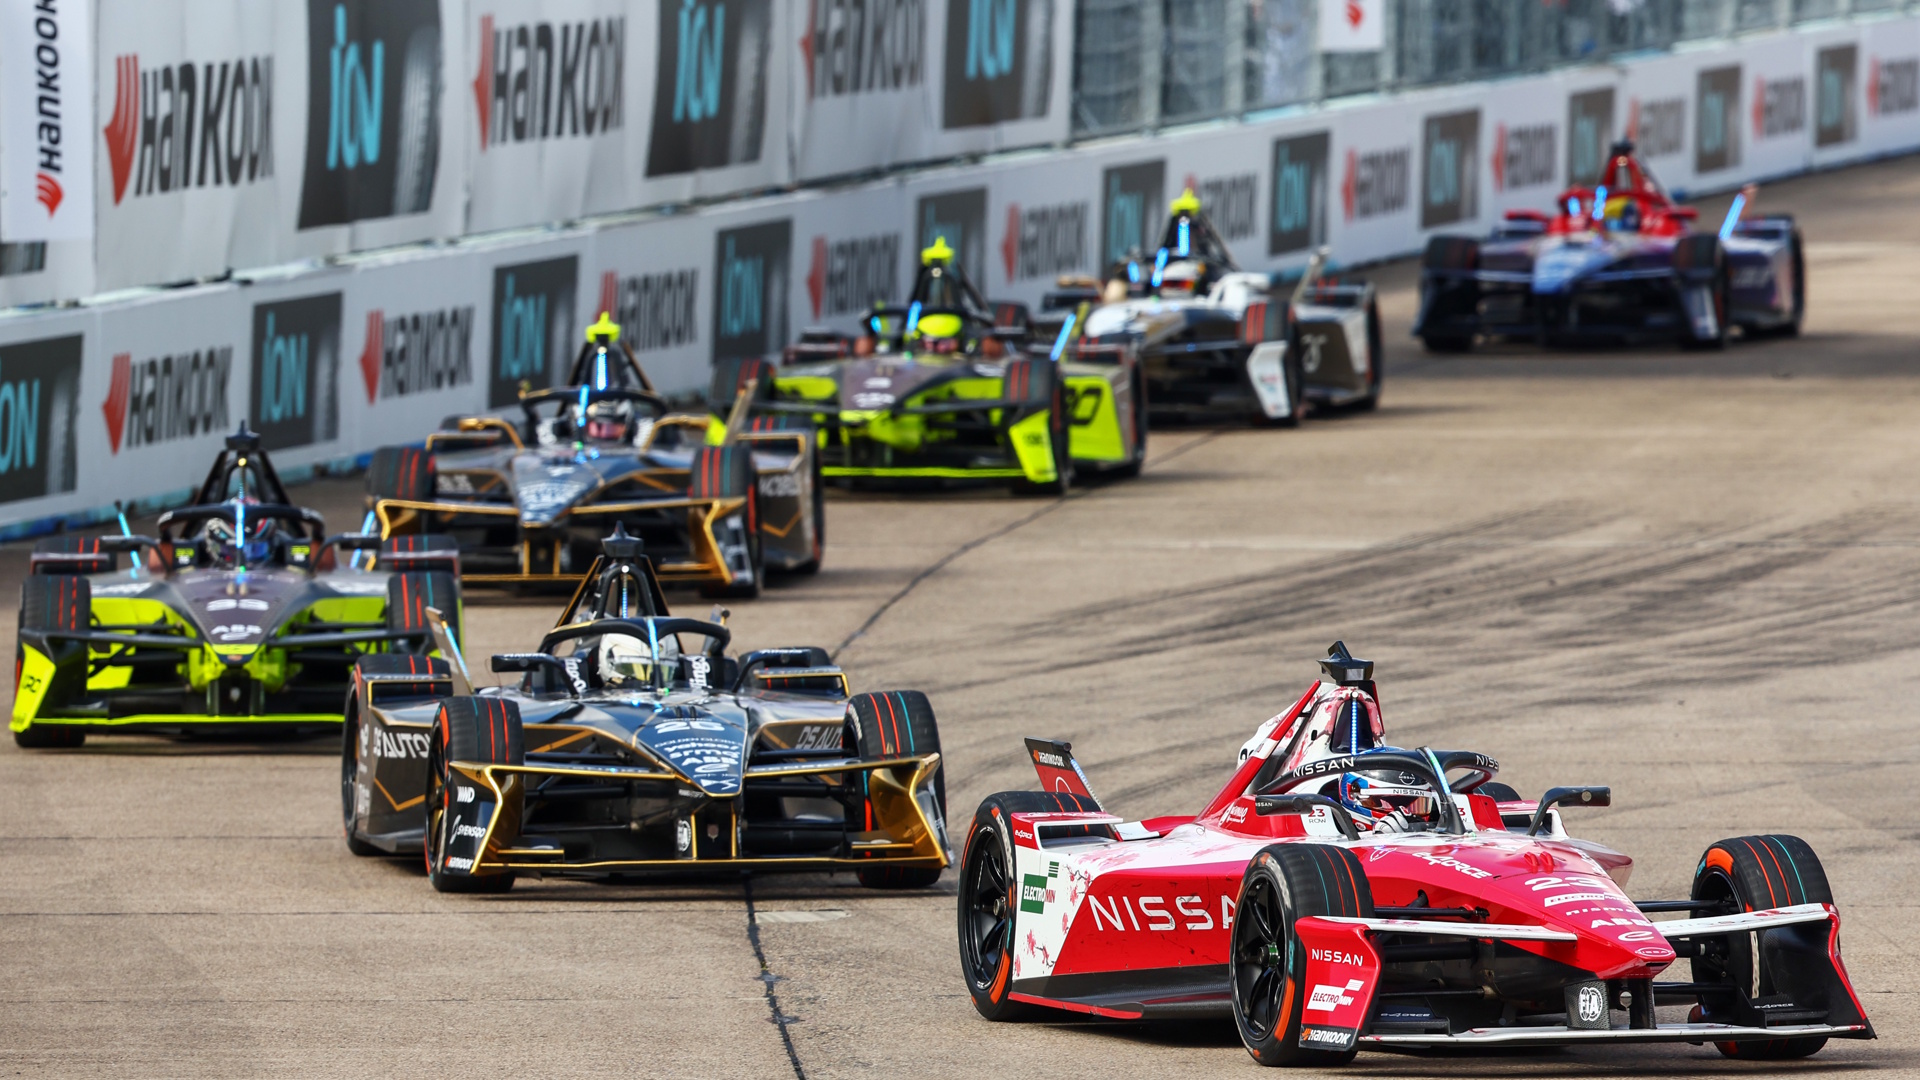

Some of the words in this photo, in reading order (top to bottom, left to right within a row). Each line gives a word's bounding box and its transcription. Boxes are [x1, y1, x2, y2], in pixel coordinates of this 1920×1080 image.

[1291, 756, 1355, 778] NISSAN
[1392, 788, 1426, 797] NISSAN
[1524, 876, 1608, 892] 23
[1311, 949, 1364, 967] NISSAN
[1312, 992, 1354, 1007] ELECTROMIN
[1308, 1029, 1351, 1045] Hankook
